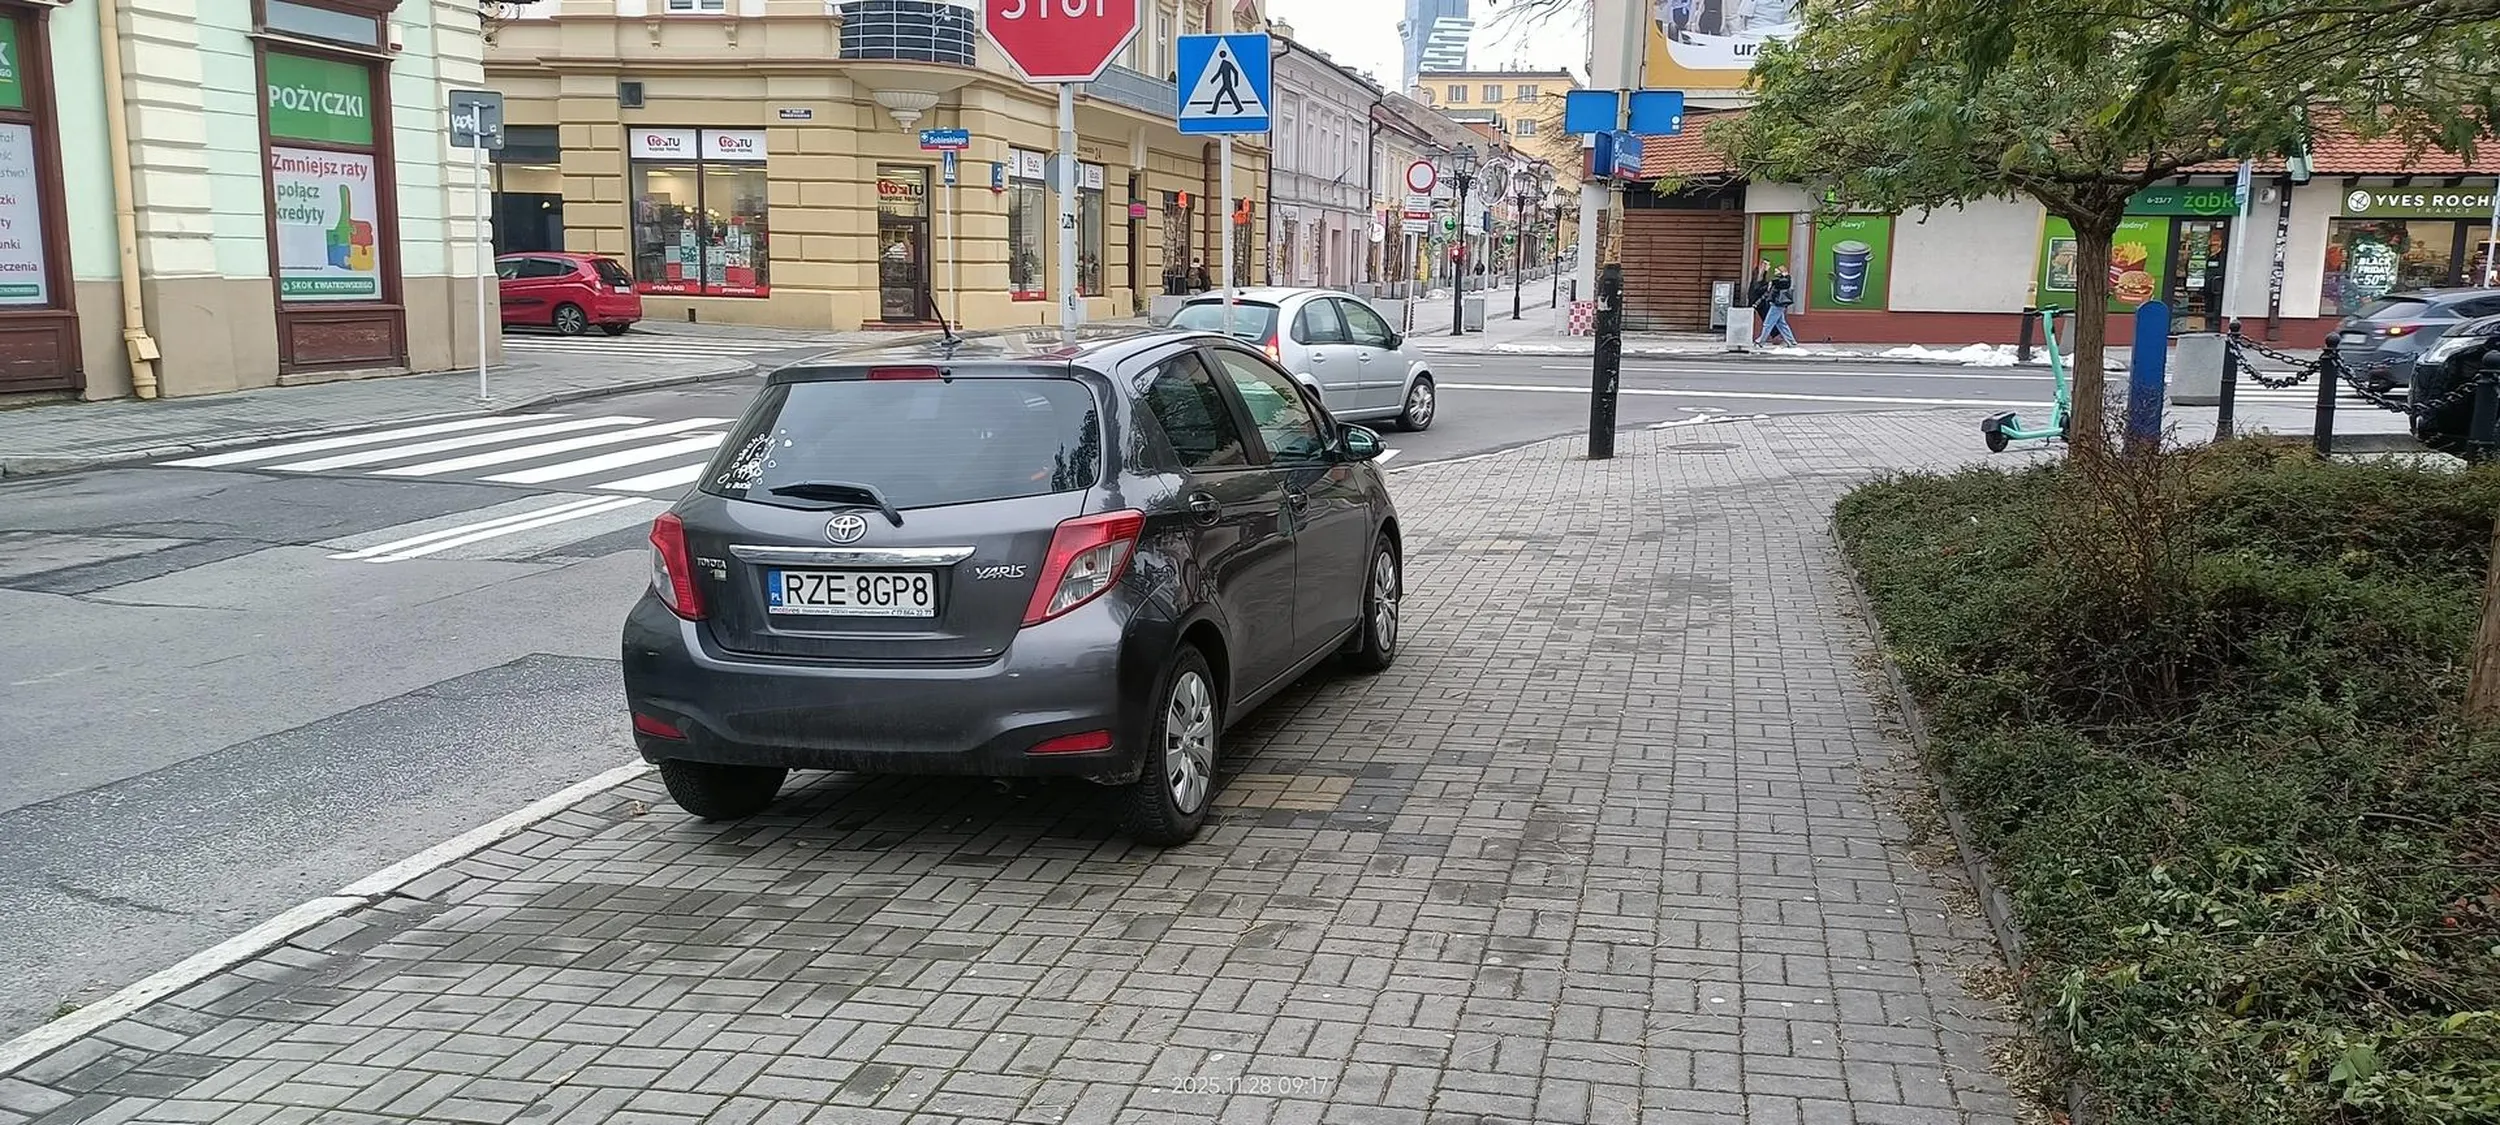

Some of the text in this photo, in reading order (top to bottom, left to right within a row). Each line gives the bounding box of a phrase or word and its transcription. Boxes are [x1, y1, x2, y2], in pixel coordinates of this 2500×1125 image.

[268, 84, 364, 118] POŻYCZKI
[272, 153, 368, 181] Zmniejsz raty
[277, 181, 320, 202] połącz
[2184, 191, 2236, 208] żabk
[2375, 195, 2497, 207] YVES ROCH
[2358, 257, 2390, 265] BLACK
[2358, 266, 2390, 274] FRIDAY
[291, 280, 313, 290] SKOK
[697, 557, 727, 569] TOYOTA
[975, 564, 1027, 579] YARIS
[771, 592, 781, 601] PL
[786, 574, 929, 606] RZE 8GP8
